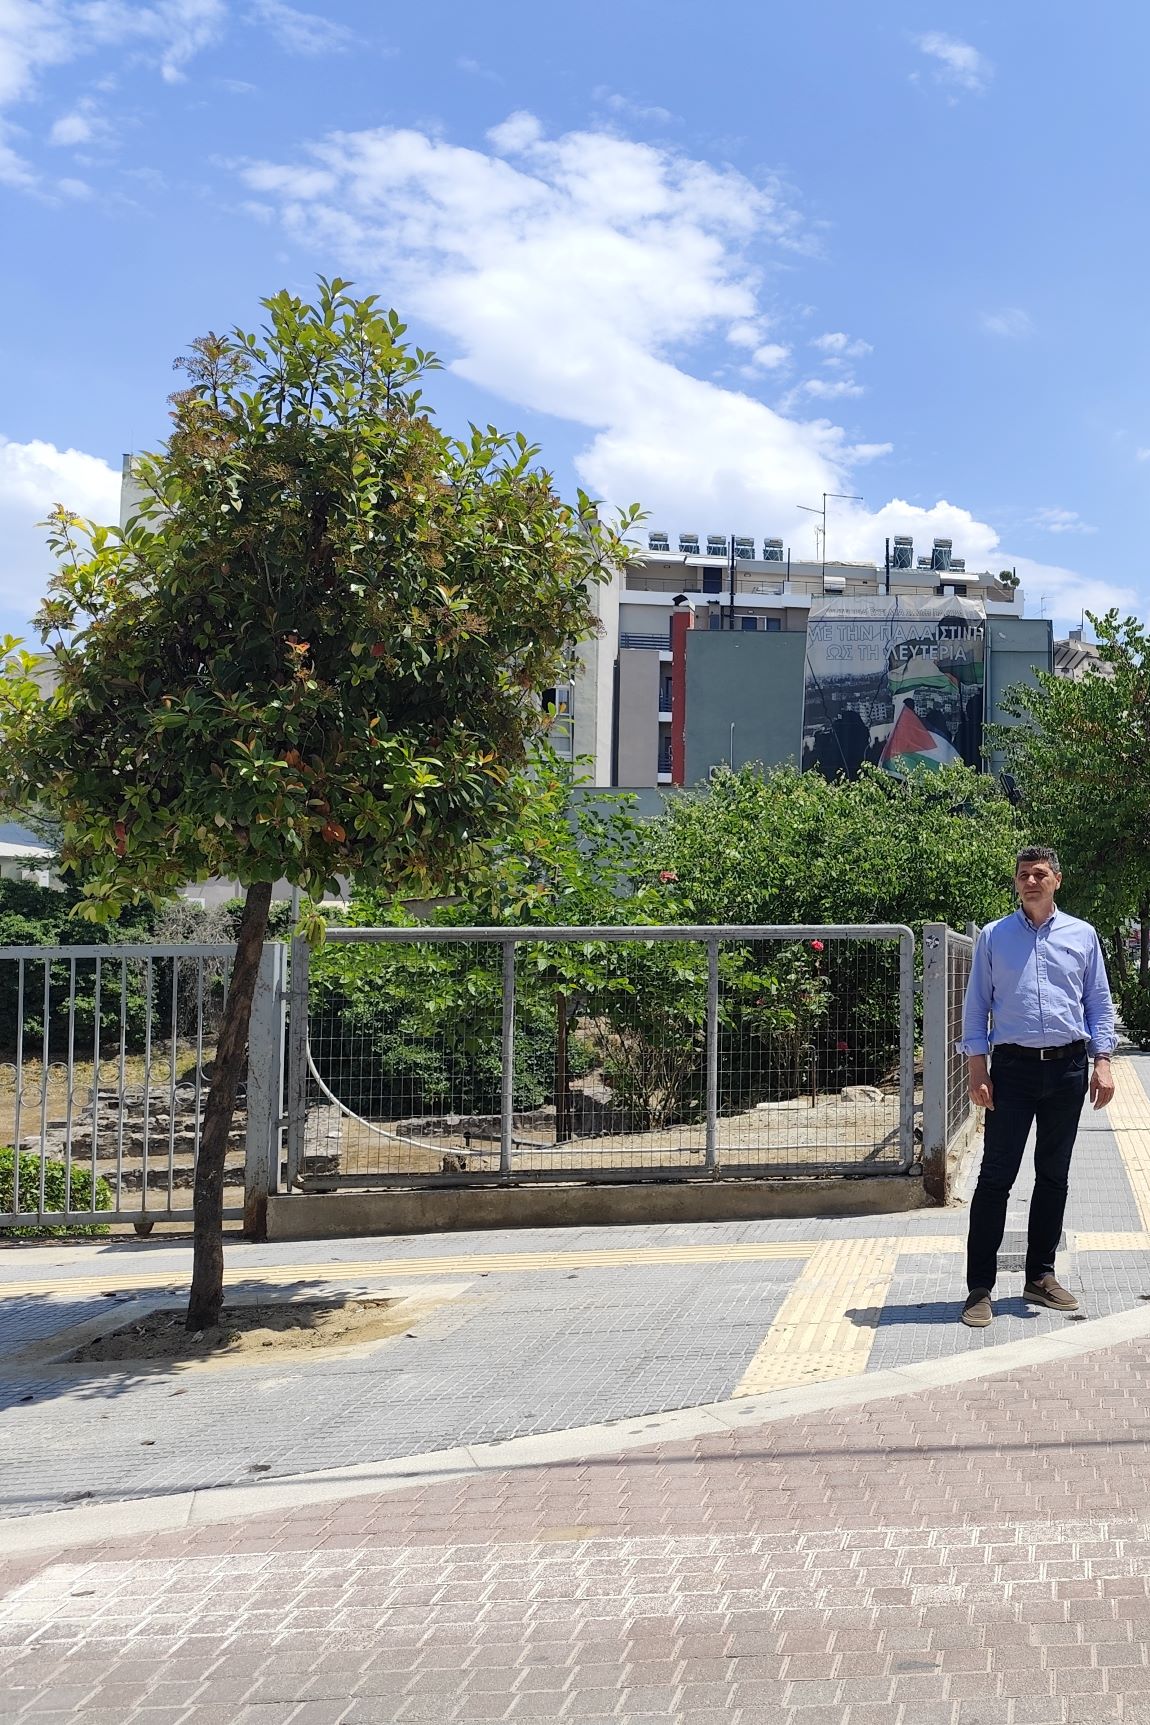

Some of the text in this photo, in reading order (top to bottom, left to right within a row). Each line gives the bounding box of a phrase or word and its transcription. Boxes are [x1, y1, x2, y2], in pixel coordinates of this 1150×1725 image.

[808, 625, 985, 642] ΜΕ ΤΗΝ ΠΑΛΑΙΣΤΙΝΗ
[826, 645, 968, 661] ΩΣ ΤΗ ΛΕΥΤΕΡΙΑ
